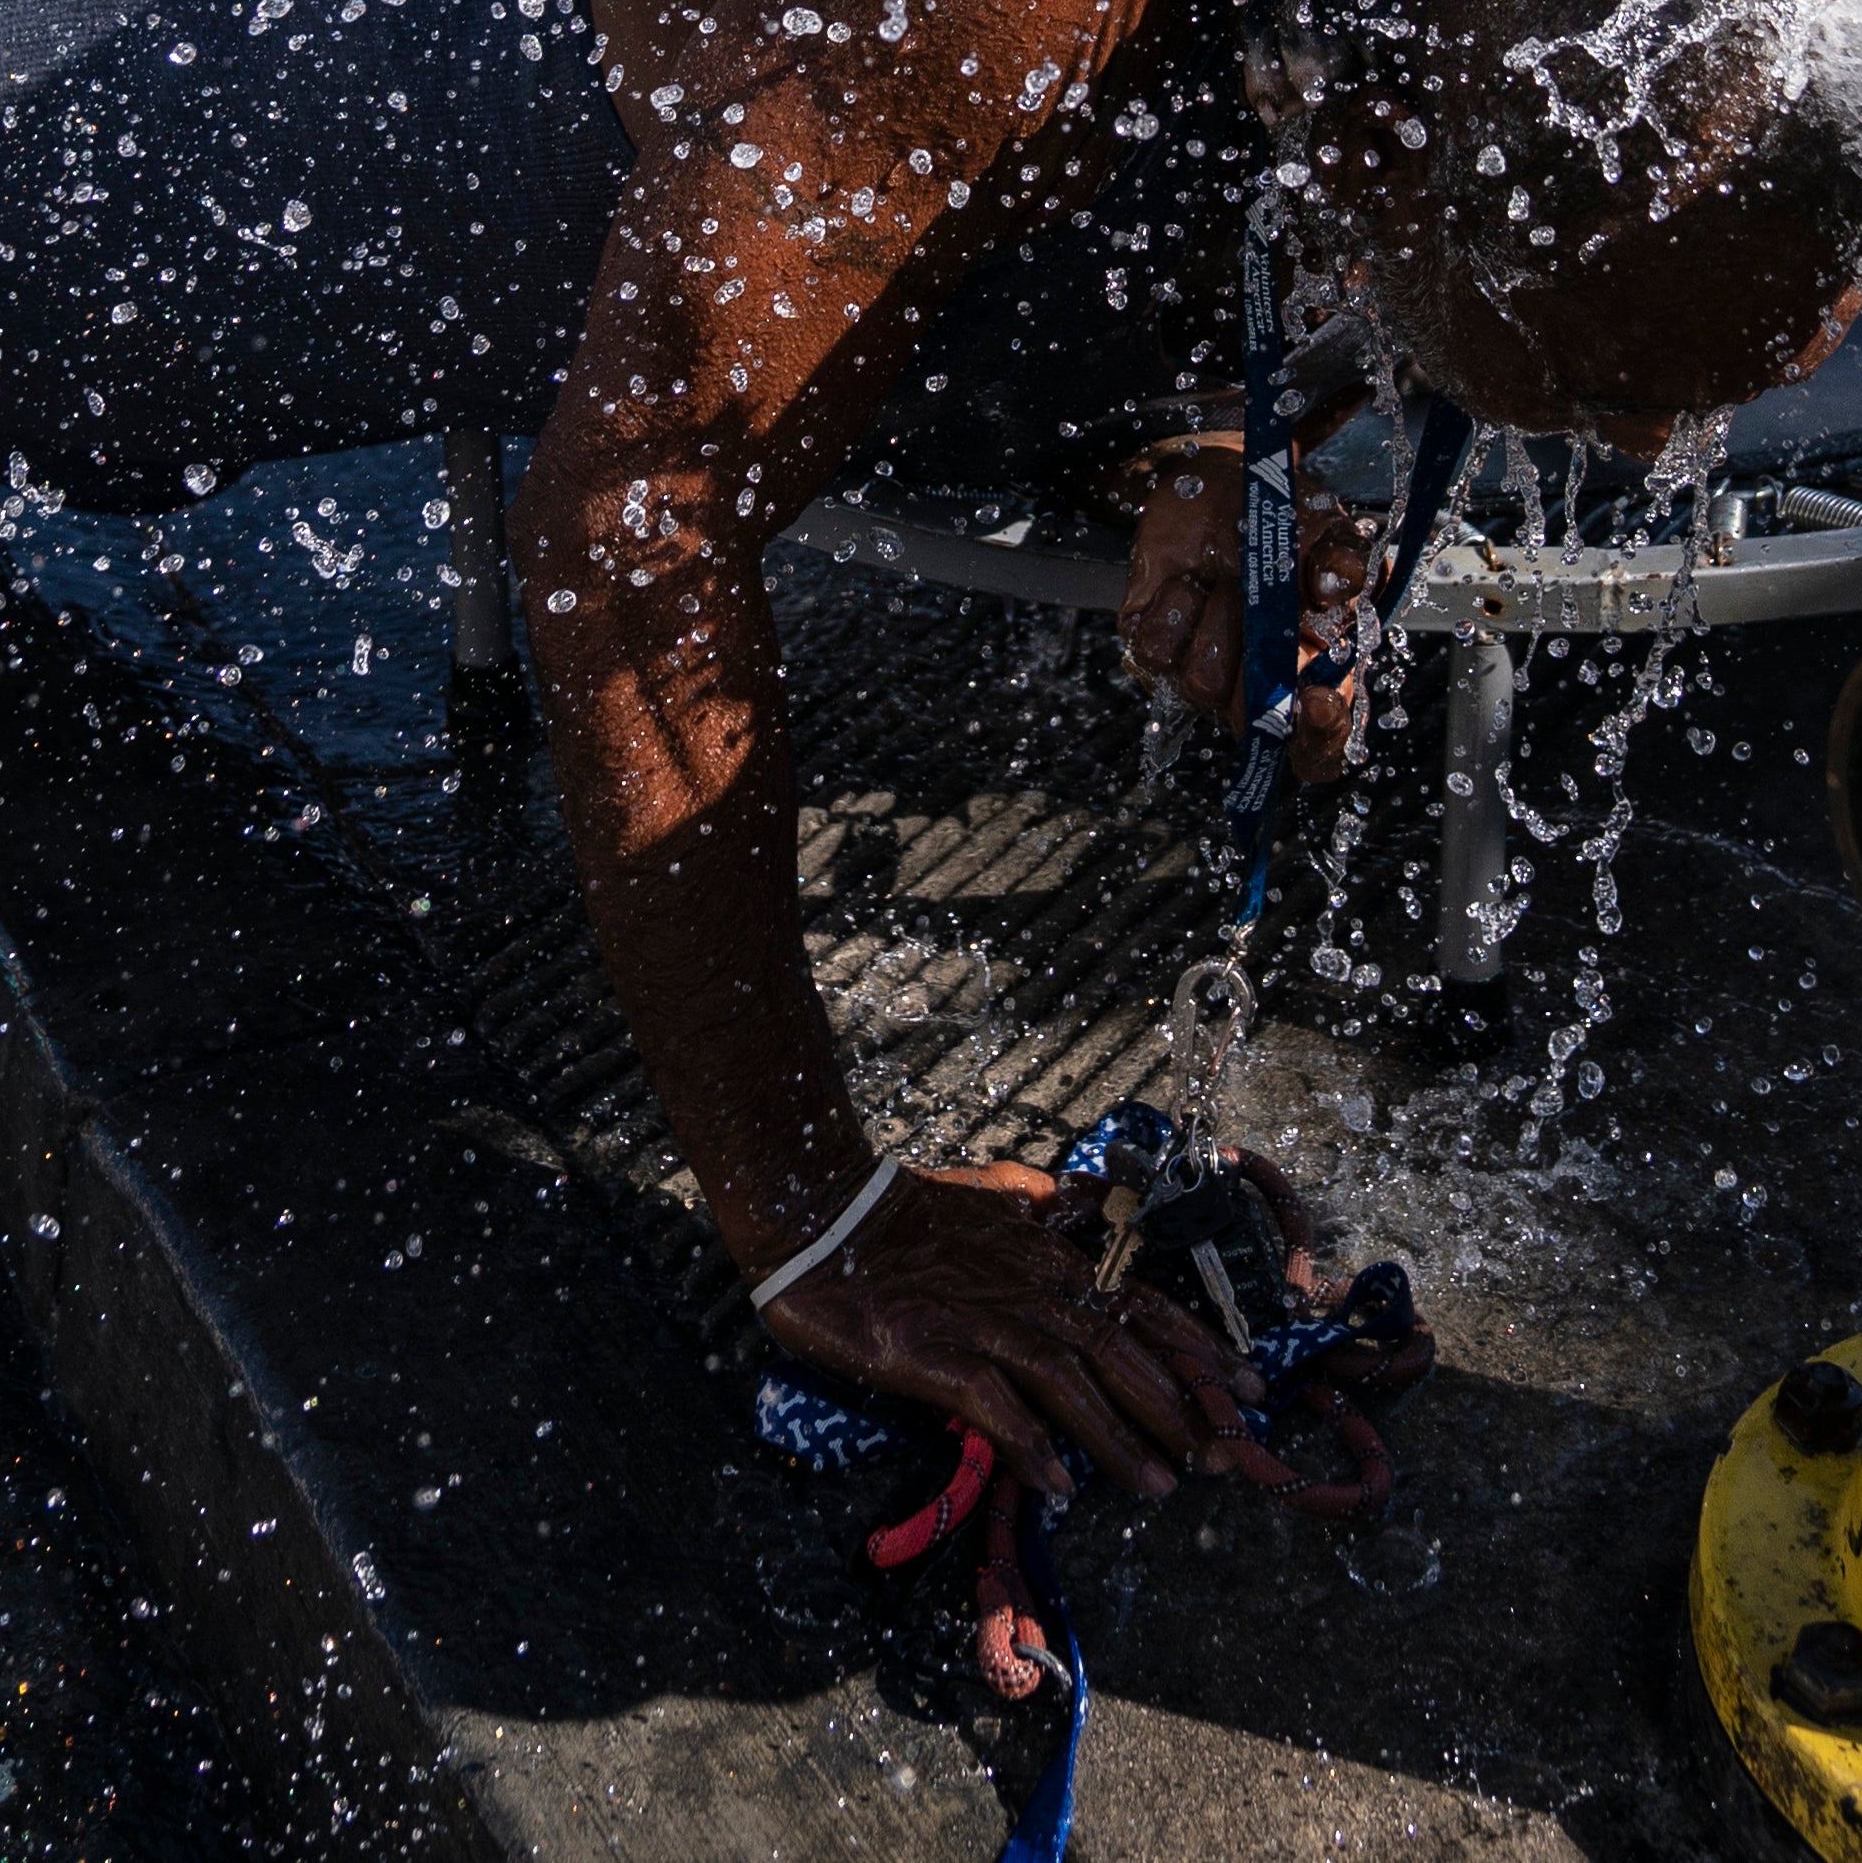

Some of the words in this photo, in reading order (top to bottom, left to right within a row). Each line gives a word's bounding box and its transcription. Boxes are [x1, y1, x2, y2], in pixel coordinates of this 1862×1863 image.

[1244, 299, 1253, 316] LOS
[1251, 266, 1266, 330] America
[1260, 252, 1275, 334] Volunteers
[1246, 316, 1257, 352] ANGELES
[1249, 480, 1260, 507] YOUTH
[1262, 499, 1276, 518] of
[1248, 509, 1259, 547] SERVICES
[1248, 551, 1259, 569] LOS
[1262, 518, 1276, 582] America
[1248, 569, 1259, 606] ANGELES
[1249, 736, 1261, 762] YOUTH
[1260, 748, 1272, 765] of
